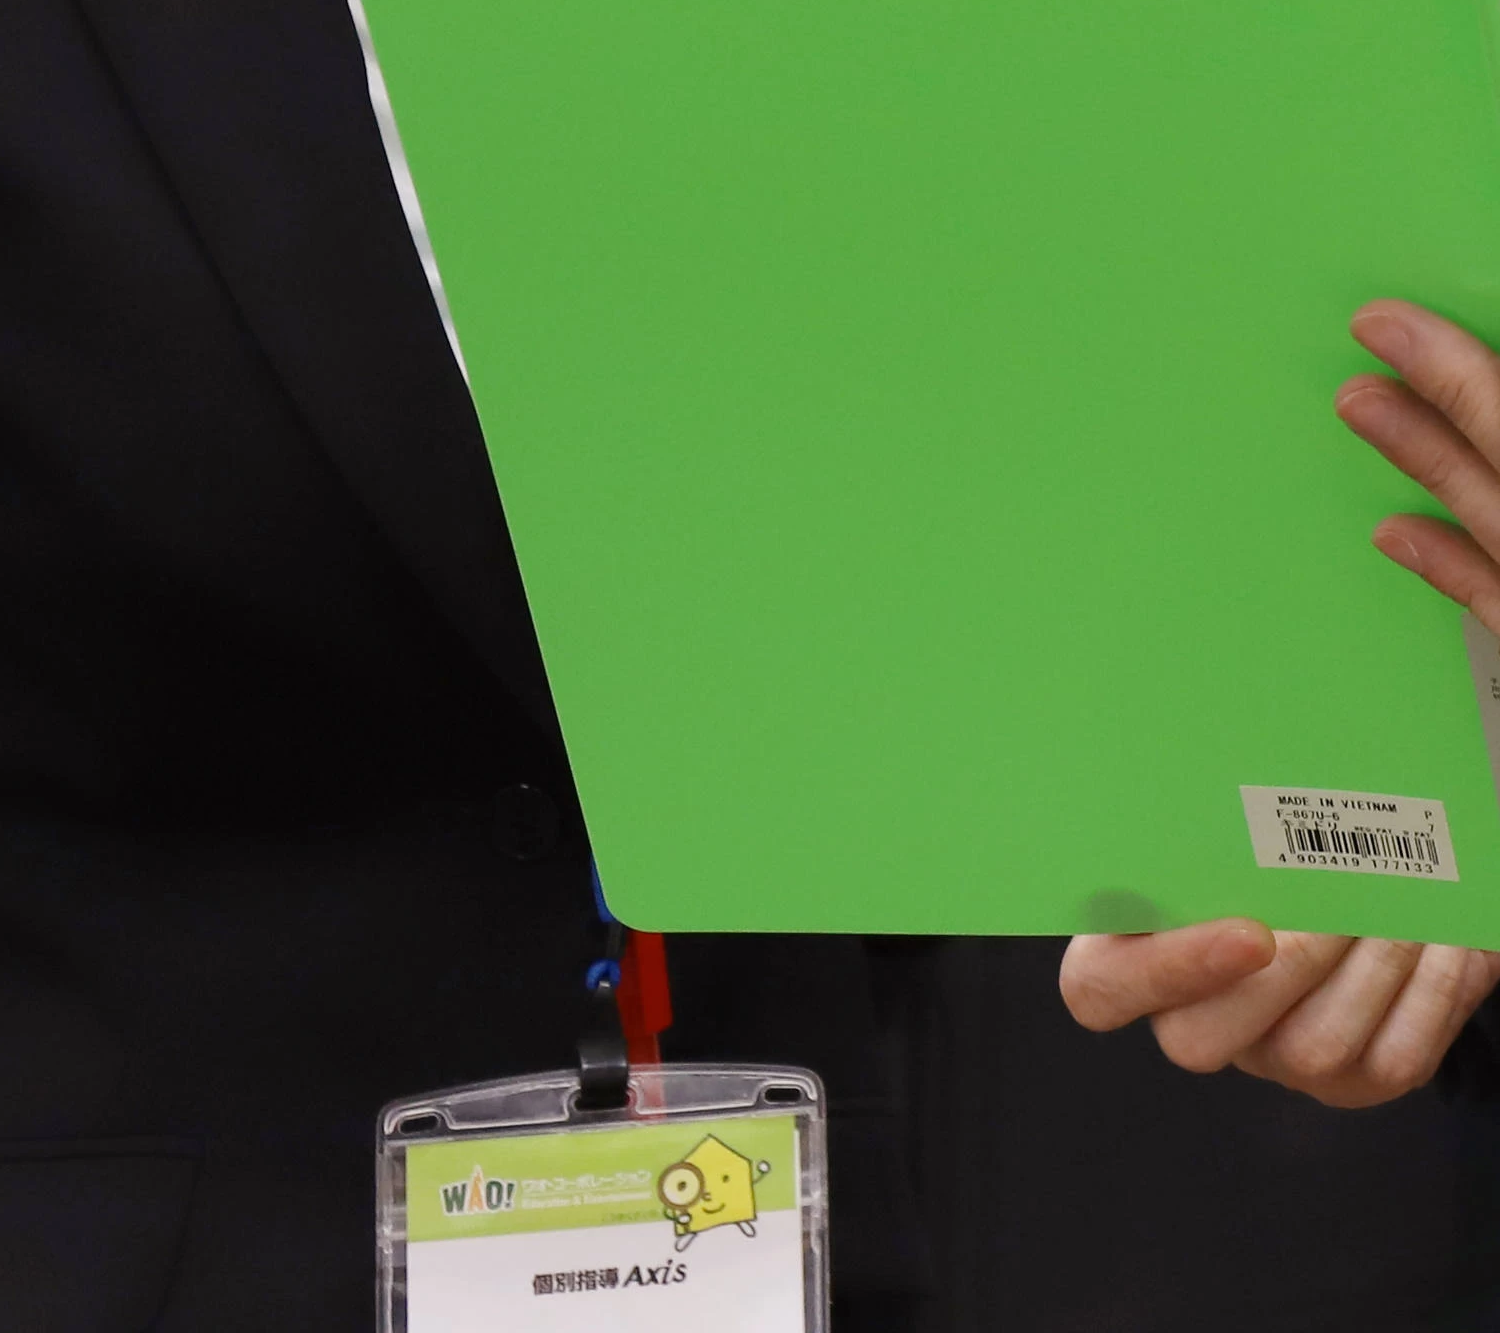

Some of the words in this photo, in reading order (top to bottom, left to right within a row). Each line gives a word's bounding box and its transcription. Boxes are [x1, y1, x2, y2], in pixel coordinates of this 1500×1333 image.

[1278, 796, 1309, 806] MADE
[1319, 797, 1334, 807] IN
[1342, 800, 1397, 813] VIETNAM
[1276, 809, 1340, 821] F-867U-6
[1424, 811, 1432, 820] P
[1278, 853, 1287, 863] 4
[1297, 854, 1360, 867] 903419
[1372, 860, 1434, 874] 177133
[622, 1258, 687, 1287] Axis
